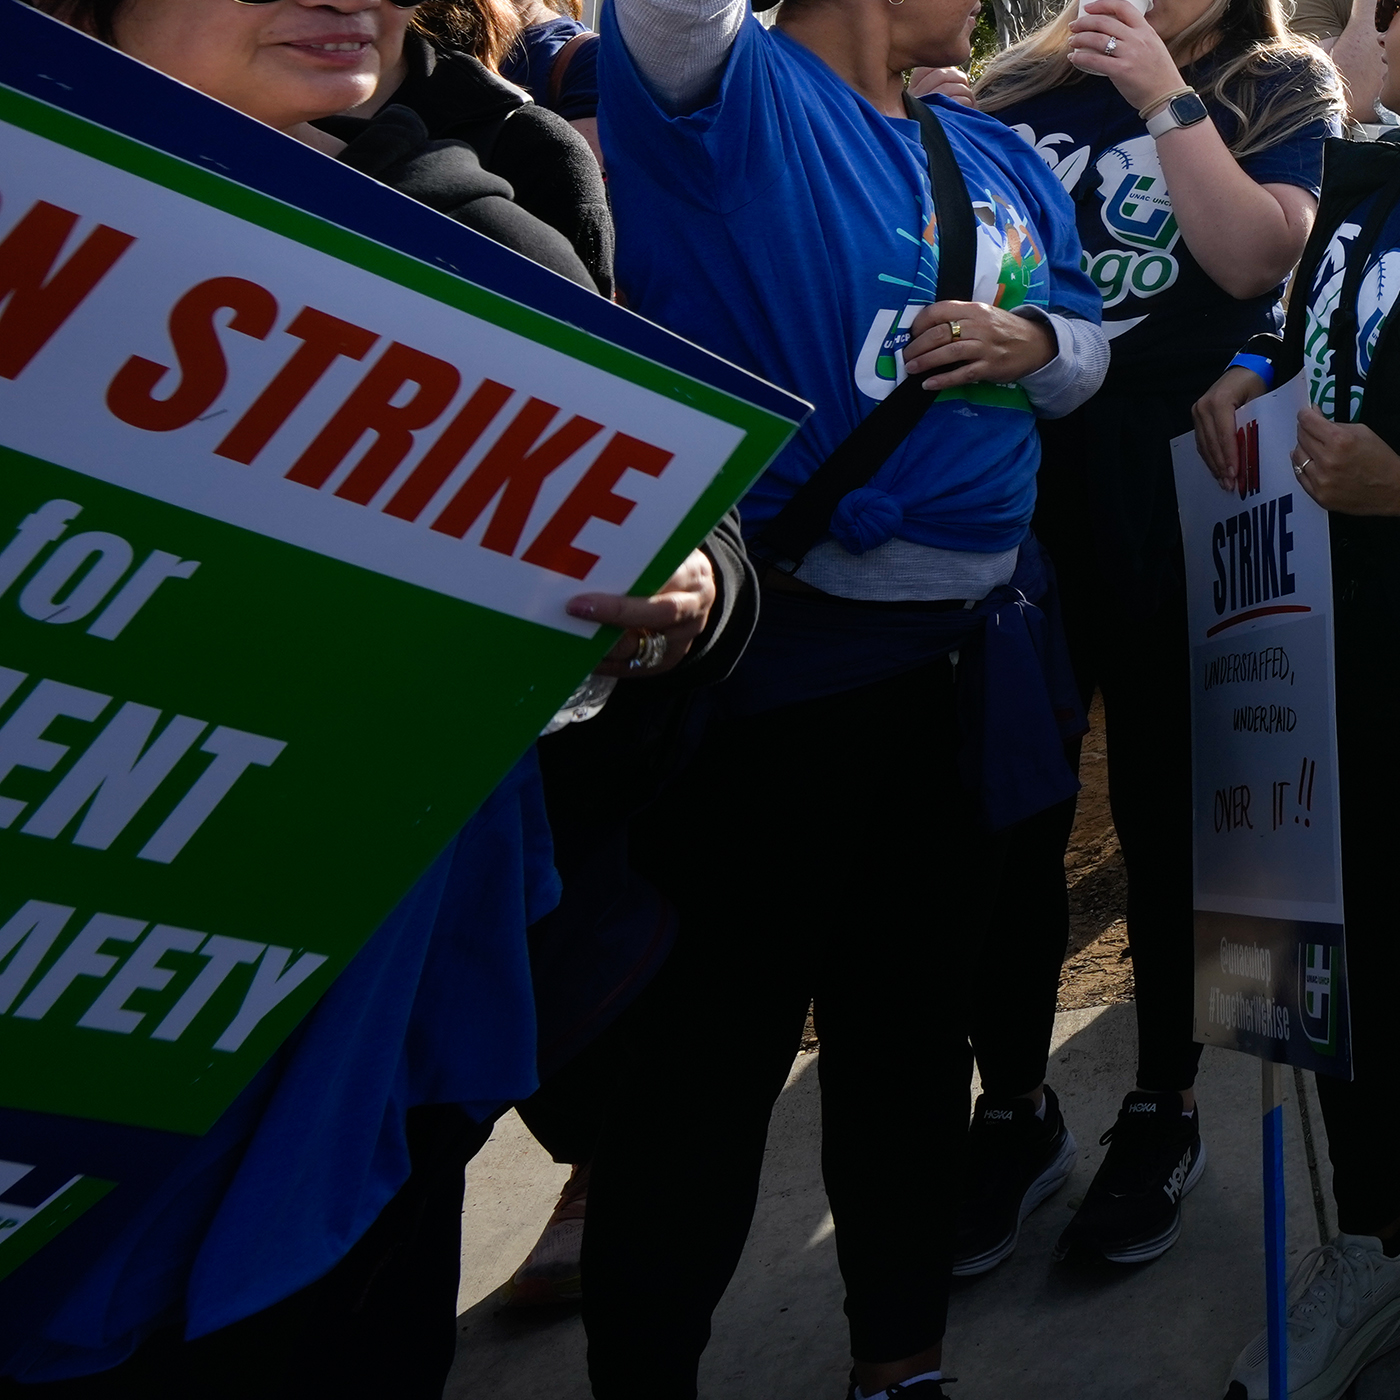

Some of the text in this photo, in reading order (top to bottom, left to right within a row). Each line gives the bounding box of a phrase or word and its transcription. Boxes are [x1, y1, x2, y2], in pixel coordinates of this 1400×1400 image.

[0, 198, 677, 582] N STRIKE
[1212, 492, 1296, 613] STRIKE
[1204, 646, 1295, 691] UNDERSTAFFED,
[1233, 704, 1298, 734] UNDERPAID
[1214, 785, 1254, 834] OVER
[0, 899, 329, 1054] AFETY
[1219, 936, 1272, 988] @unacuhcp
[1208, 986, 1291, 1041] #TogetherWeRise
[983, 1109, 1015, 1121] HOKA
[1128, 1102, 1157, 1114] HOKA
[1163, 1144, 1193, 1205] HOKA
